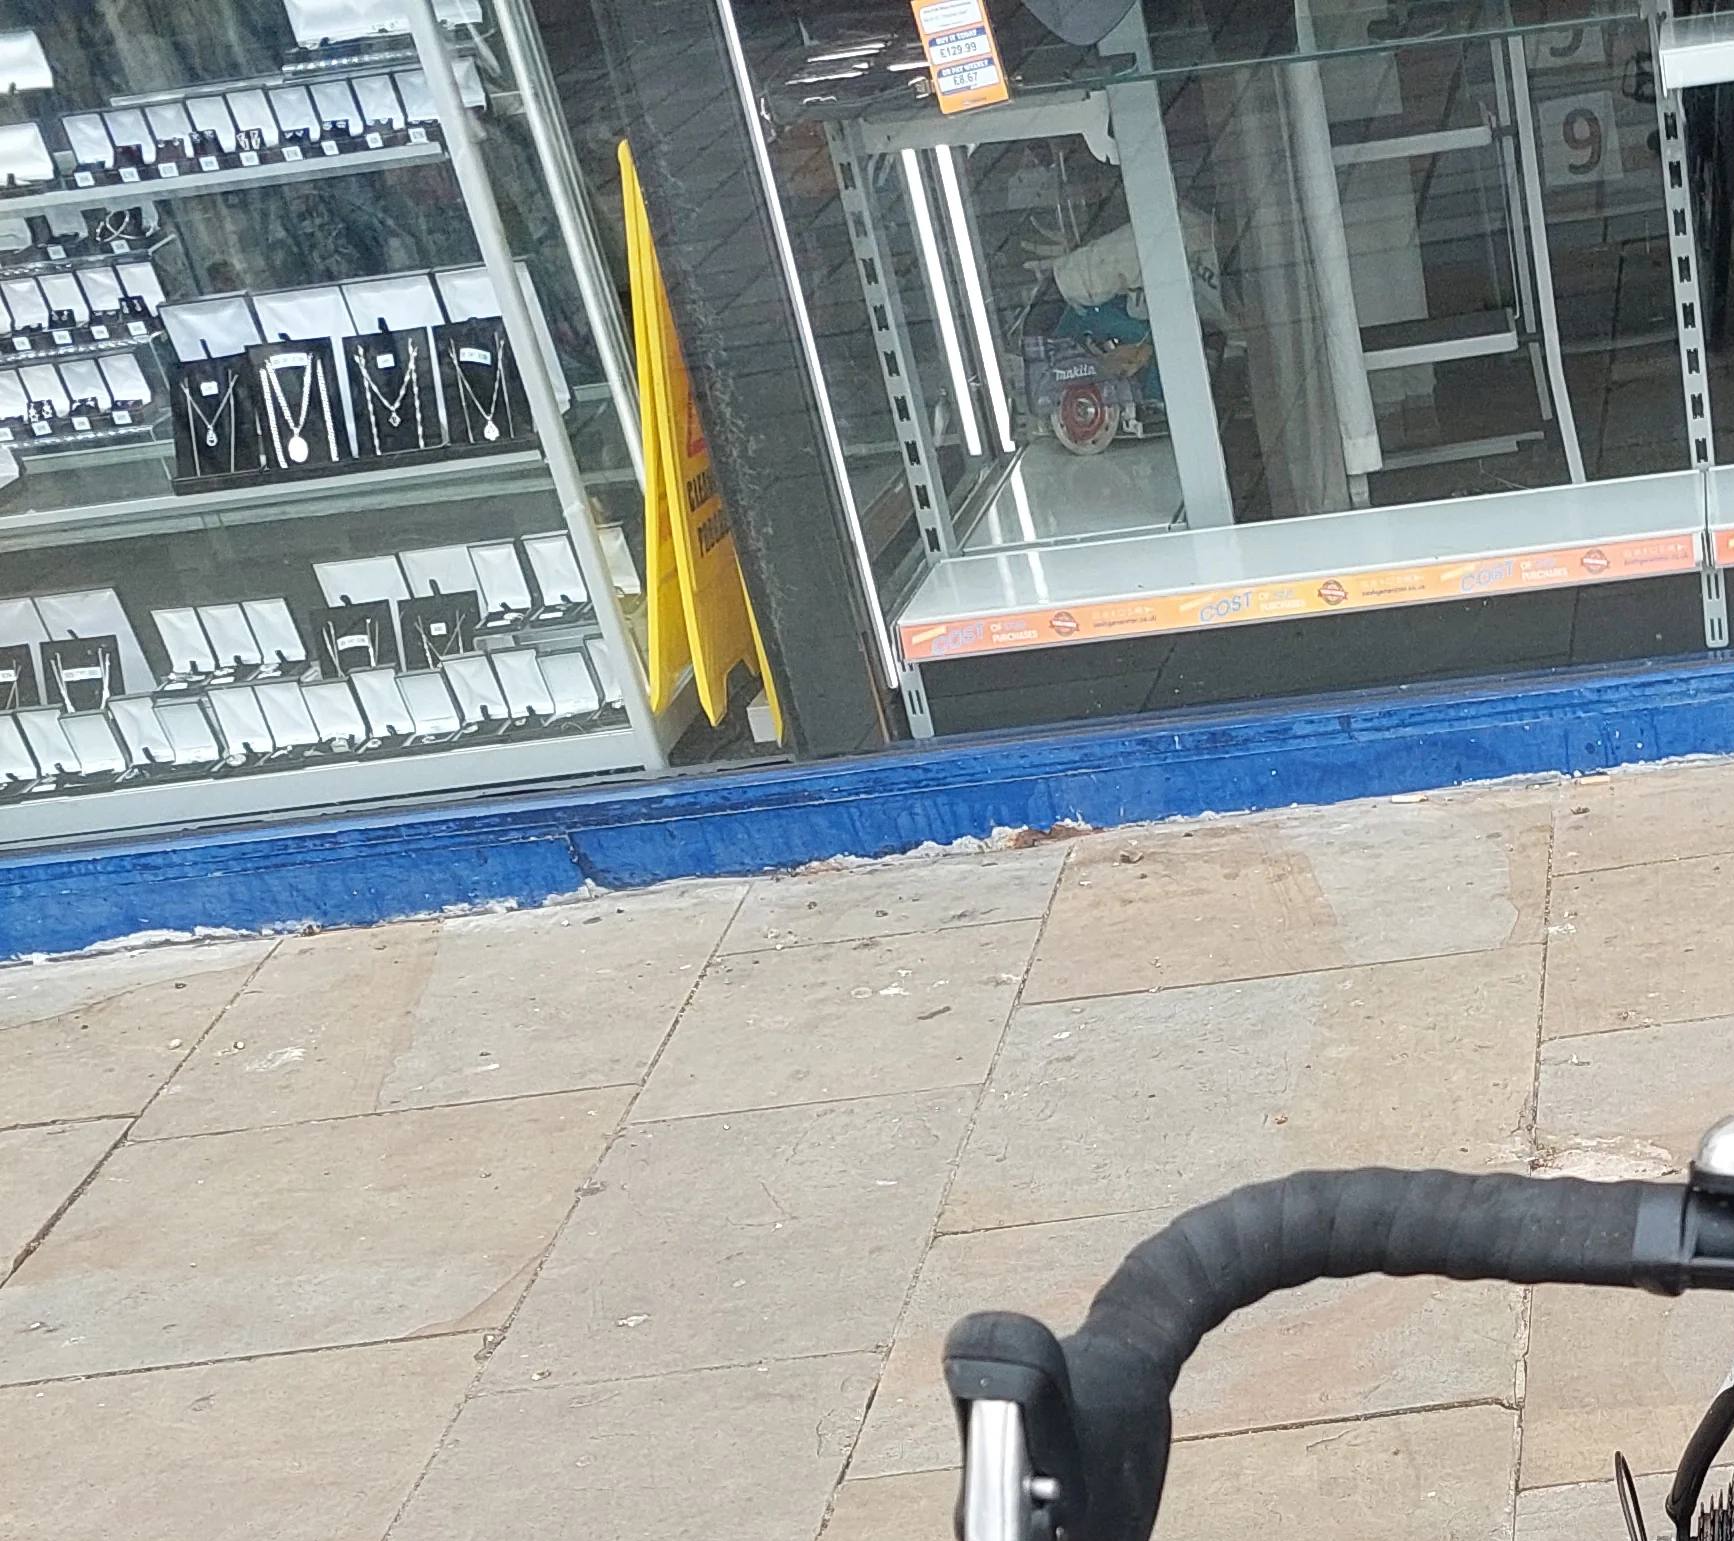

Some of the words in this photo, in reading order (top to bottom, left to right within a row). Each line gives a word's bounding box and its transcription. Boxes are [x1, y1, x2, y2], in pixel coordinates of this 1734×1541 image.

[940, 41, 977, 58] £129.99
[953, 72, 978, 86] £8.67
[1053, 363, 1098, 381] makita
[1460, 560, 1516, 593] COST
[1200, 591, 1253, 623] COST
[931, 621, 985, 655] COST
